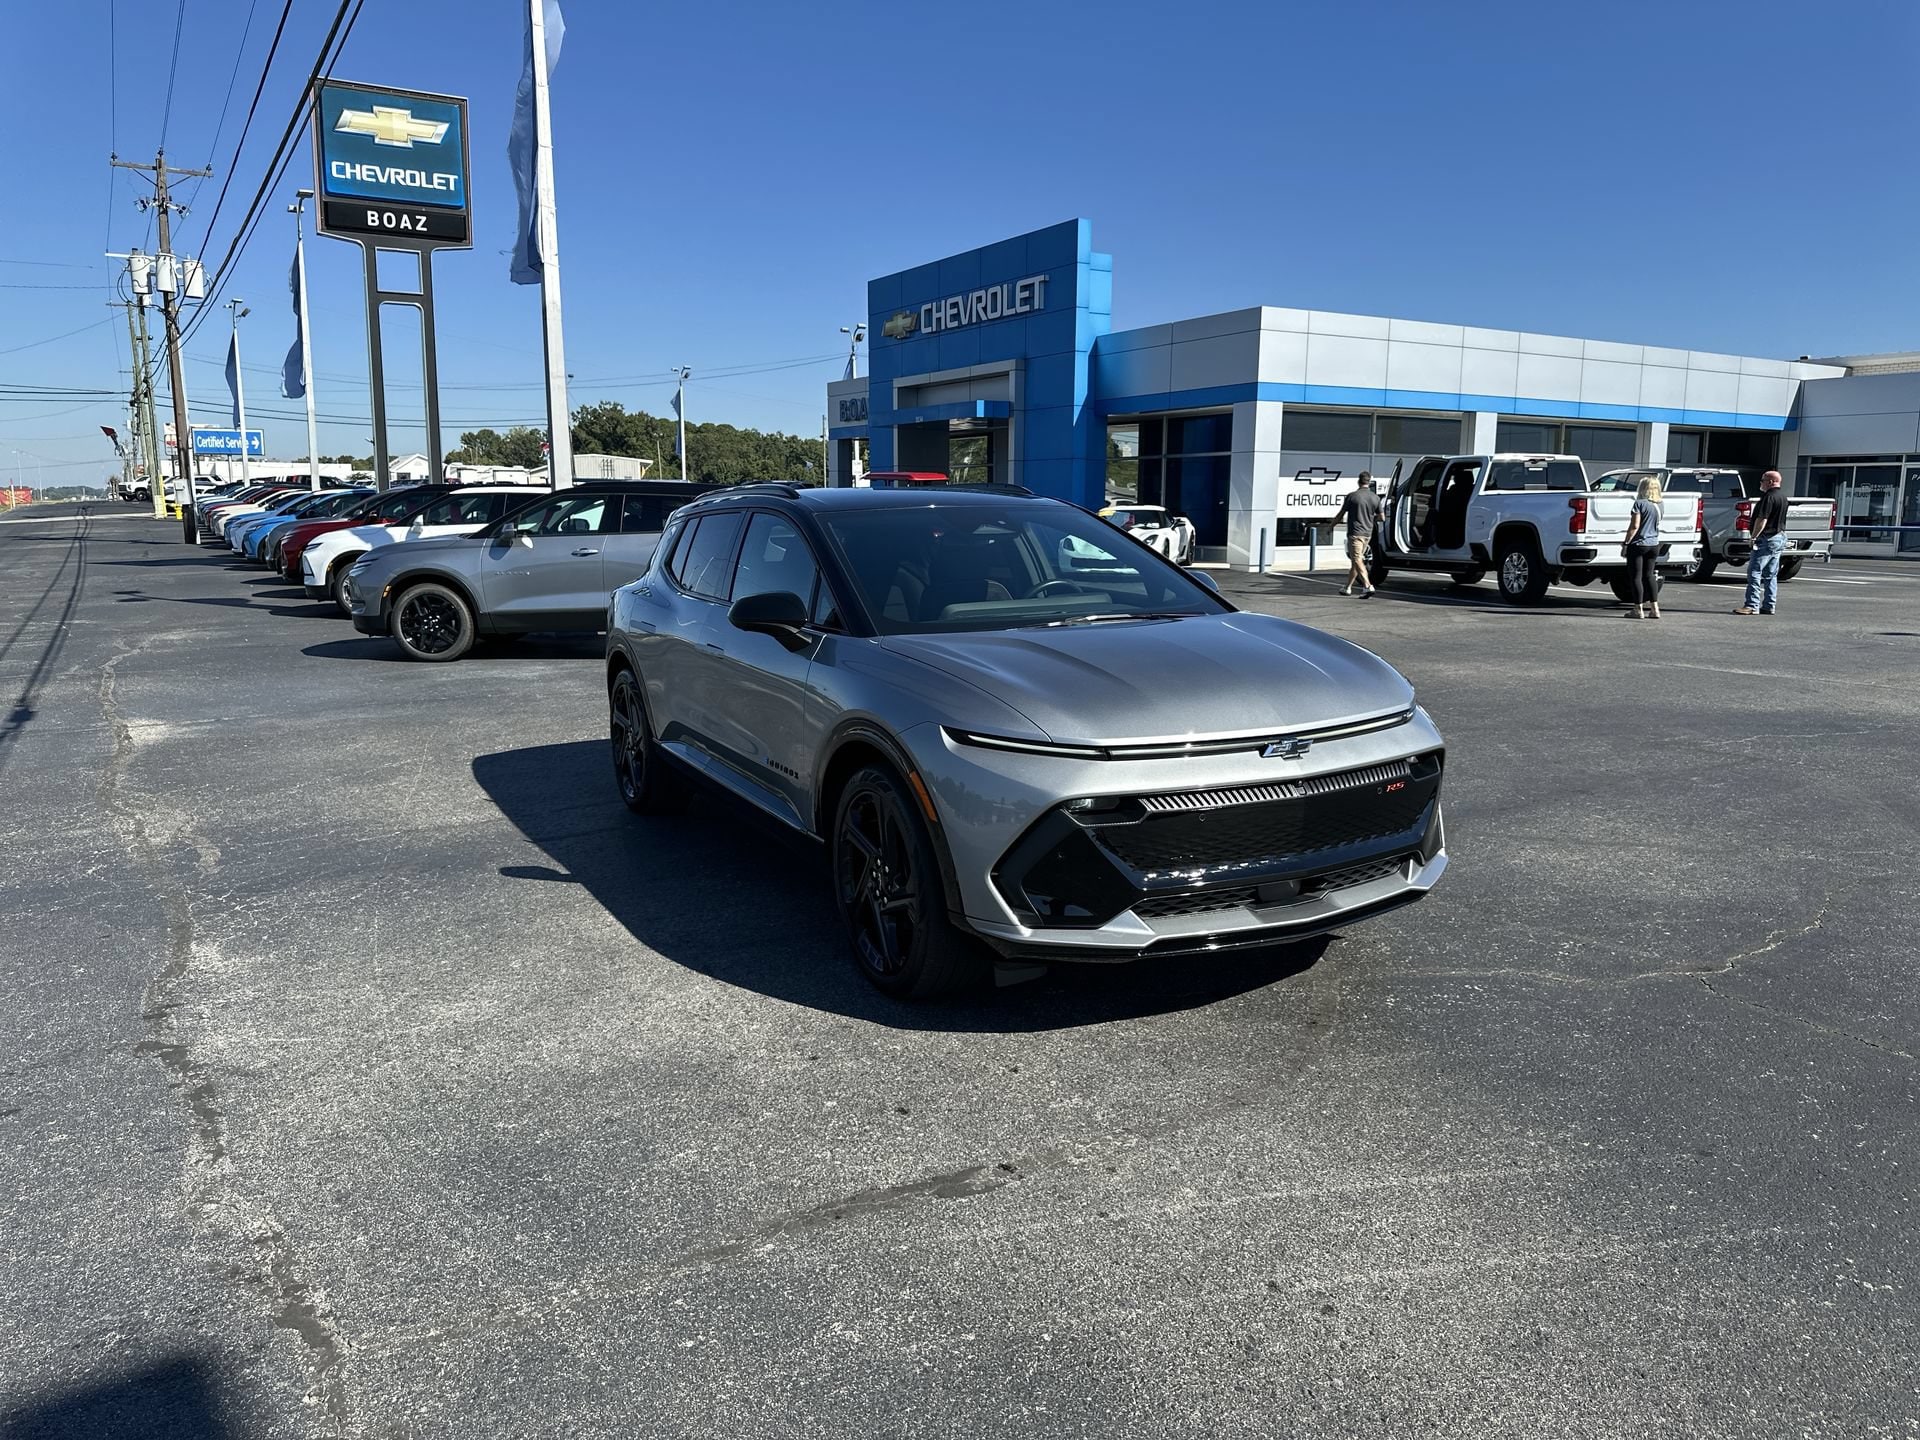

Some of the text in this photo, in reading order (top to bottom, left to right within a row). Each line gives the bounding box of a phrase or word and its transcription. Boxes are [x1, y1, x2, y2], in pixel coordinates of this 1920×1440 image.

[331, 161, 458, 191] CHEVROLET
[367, 210, 428, 232] BOAZ
[920, 274, 1049, 334] CHEVROLET
[196, 435, 250, 449] Certified Servie
[1386, 781, 1406, 792] RS
